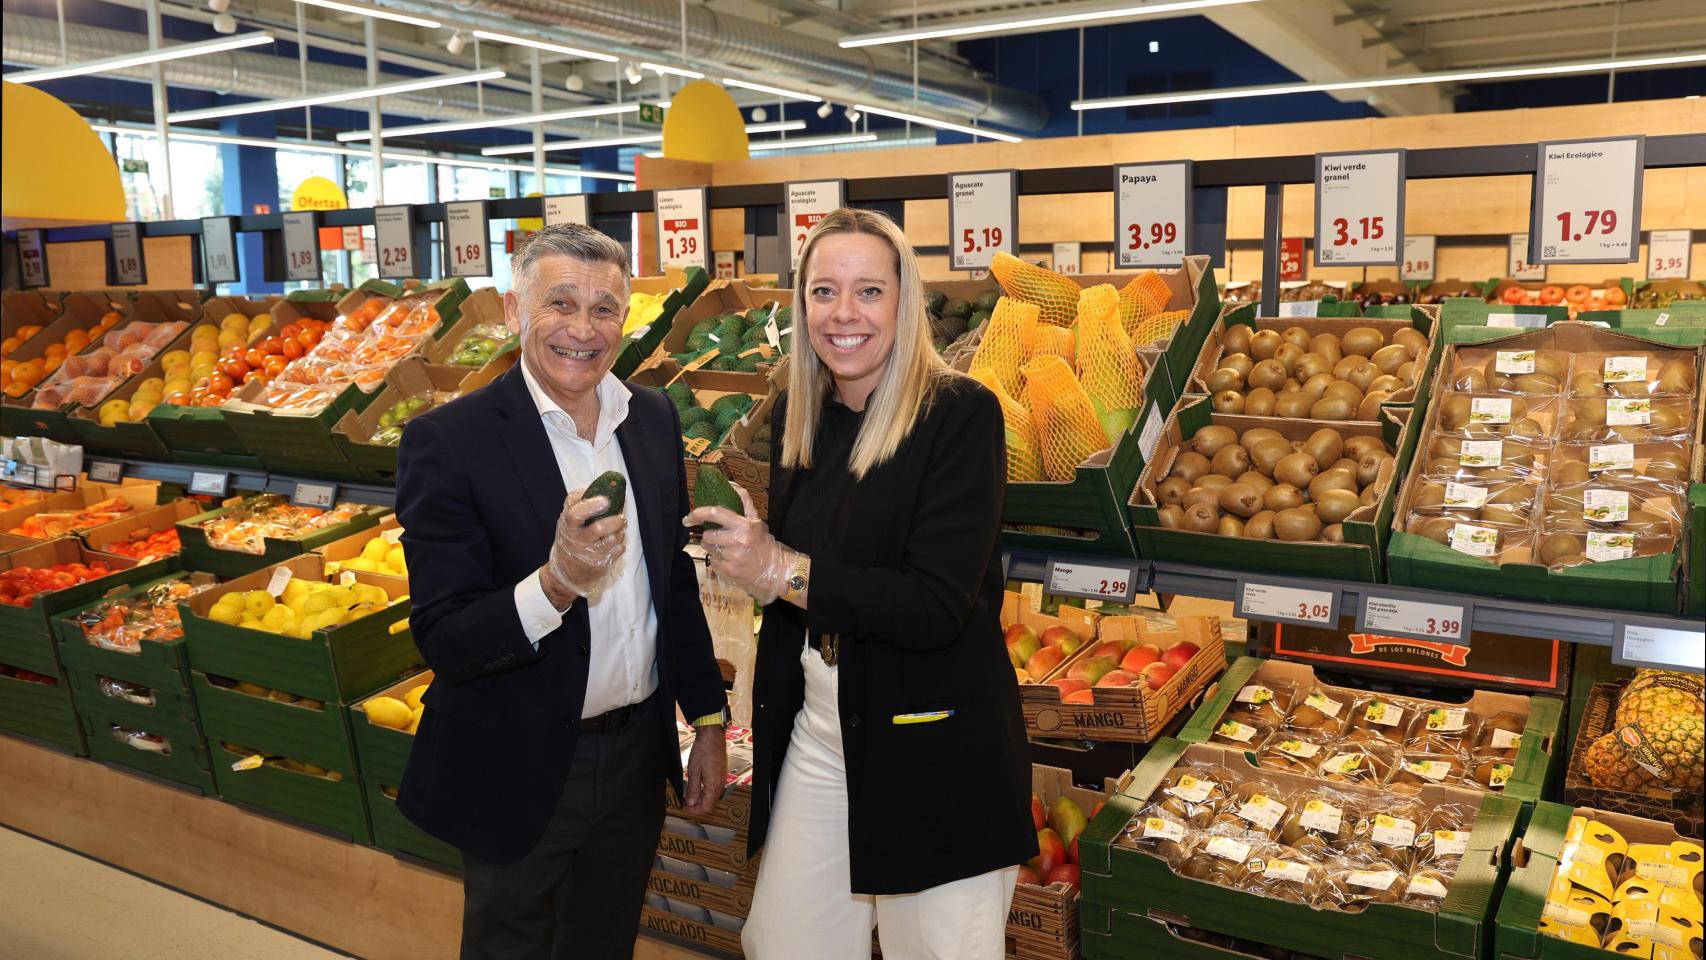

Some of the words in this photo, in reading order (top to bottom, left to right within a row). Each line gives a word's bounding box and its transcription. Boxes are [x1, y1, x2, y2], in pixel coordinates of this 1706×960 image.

[1548, 152, 1565, 160] Kiwi
[1566, 151, 1603, 160] Ecológico
[1324, 164, 1342, 172] Kiwi
[1343, 162, 1366, 171] verde
[955, 181, 984, 190] Aguacate
[1122, 174, 1157, 185] Papaya
[1324, 173, 1350, 183] granel
[790, 190, 816, 198] Aguacate
[955, 190, 975, 198] granel
[298, 196, 340, 209] Ofertas
[659, 203, 683, 212] ecológico
[675, 220, 688, 228] BIO
[808, 215, 822, 223] BIO
[1556, 209, 1618, 242] 1.79
[1128, 222, 1177, 250] 3.99
[1333, 216, 1384, 246] 3.15
[666, 236, 698, 259] 1.39
[963, 227, 1003, 253] 5.19
[291, 250, 312, 269] 1.89
[383, 246, 408, 267] 2.29
[455, 244, 481, 265] 1.69
[1405, 261, 1430, 273] 3.89
[1655, 257, 1683, 271] 3.95
[1099, 580, 1127, 595] 2.99
[1298, 603, 1329, 619] 3.05
[1426, 618, 1460, 635] 3.99
[1407, 648, 1439, 659] MELONES
[1177, 665, 1198, 698] MANGO
[1072, 711, 1125, 728] MANGO
[659, 836, 697, 857] CADO
[648, 876, 701, 899] VOCADO
[1007, 909, 1042, 929] NGO
[647, 917, 707, 942] AVOCADO
